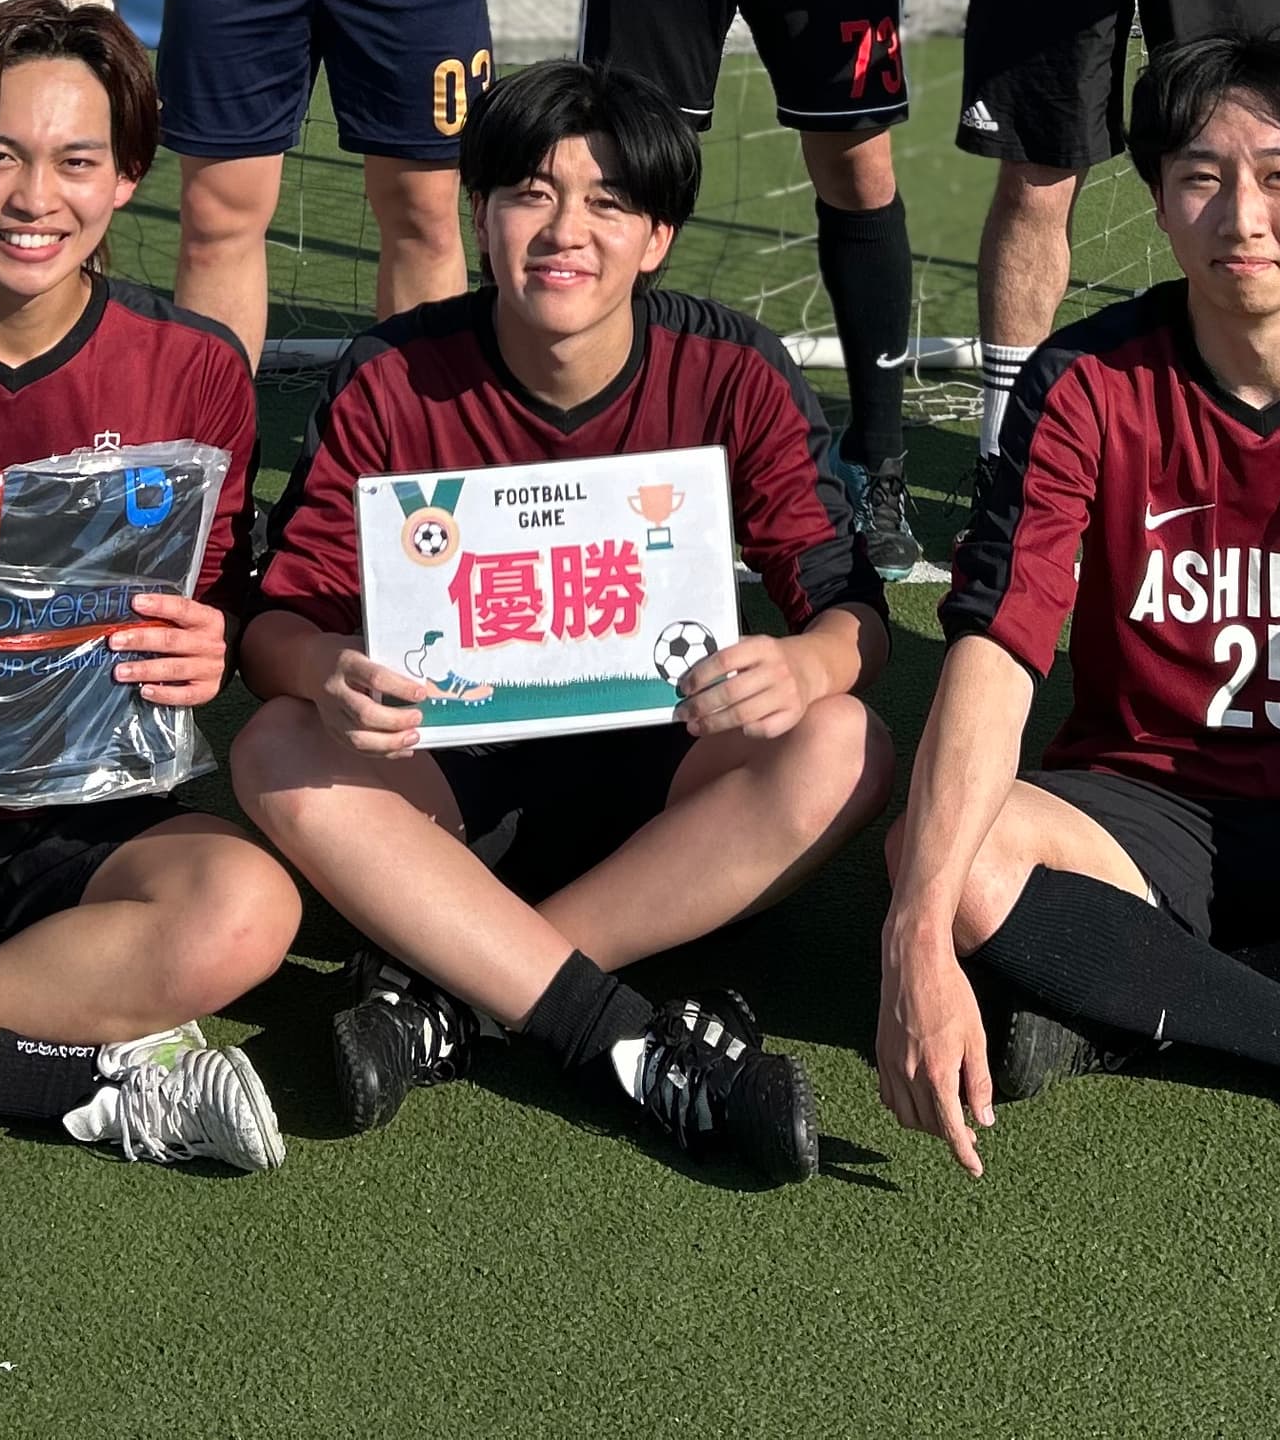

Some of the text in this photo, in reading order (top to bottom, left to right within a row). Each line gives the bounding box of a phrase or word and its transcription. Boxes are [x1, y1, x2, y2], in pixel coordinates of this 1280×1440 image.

[839, 16, 902, 99] 73
[493, 482, 588, 507] FOOTBALL
[518, 508, 566, 529] GAME
[448, 538, 648, 651] 優勝
